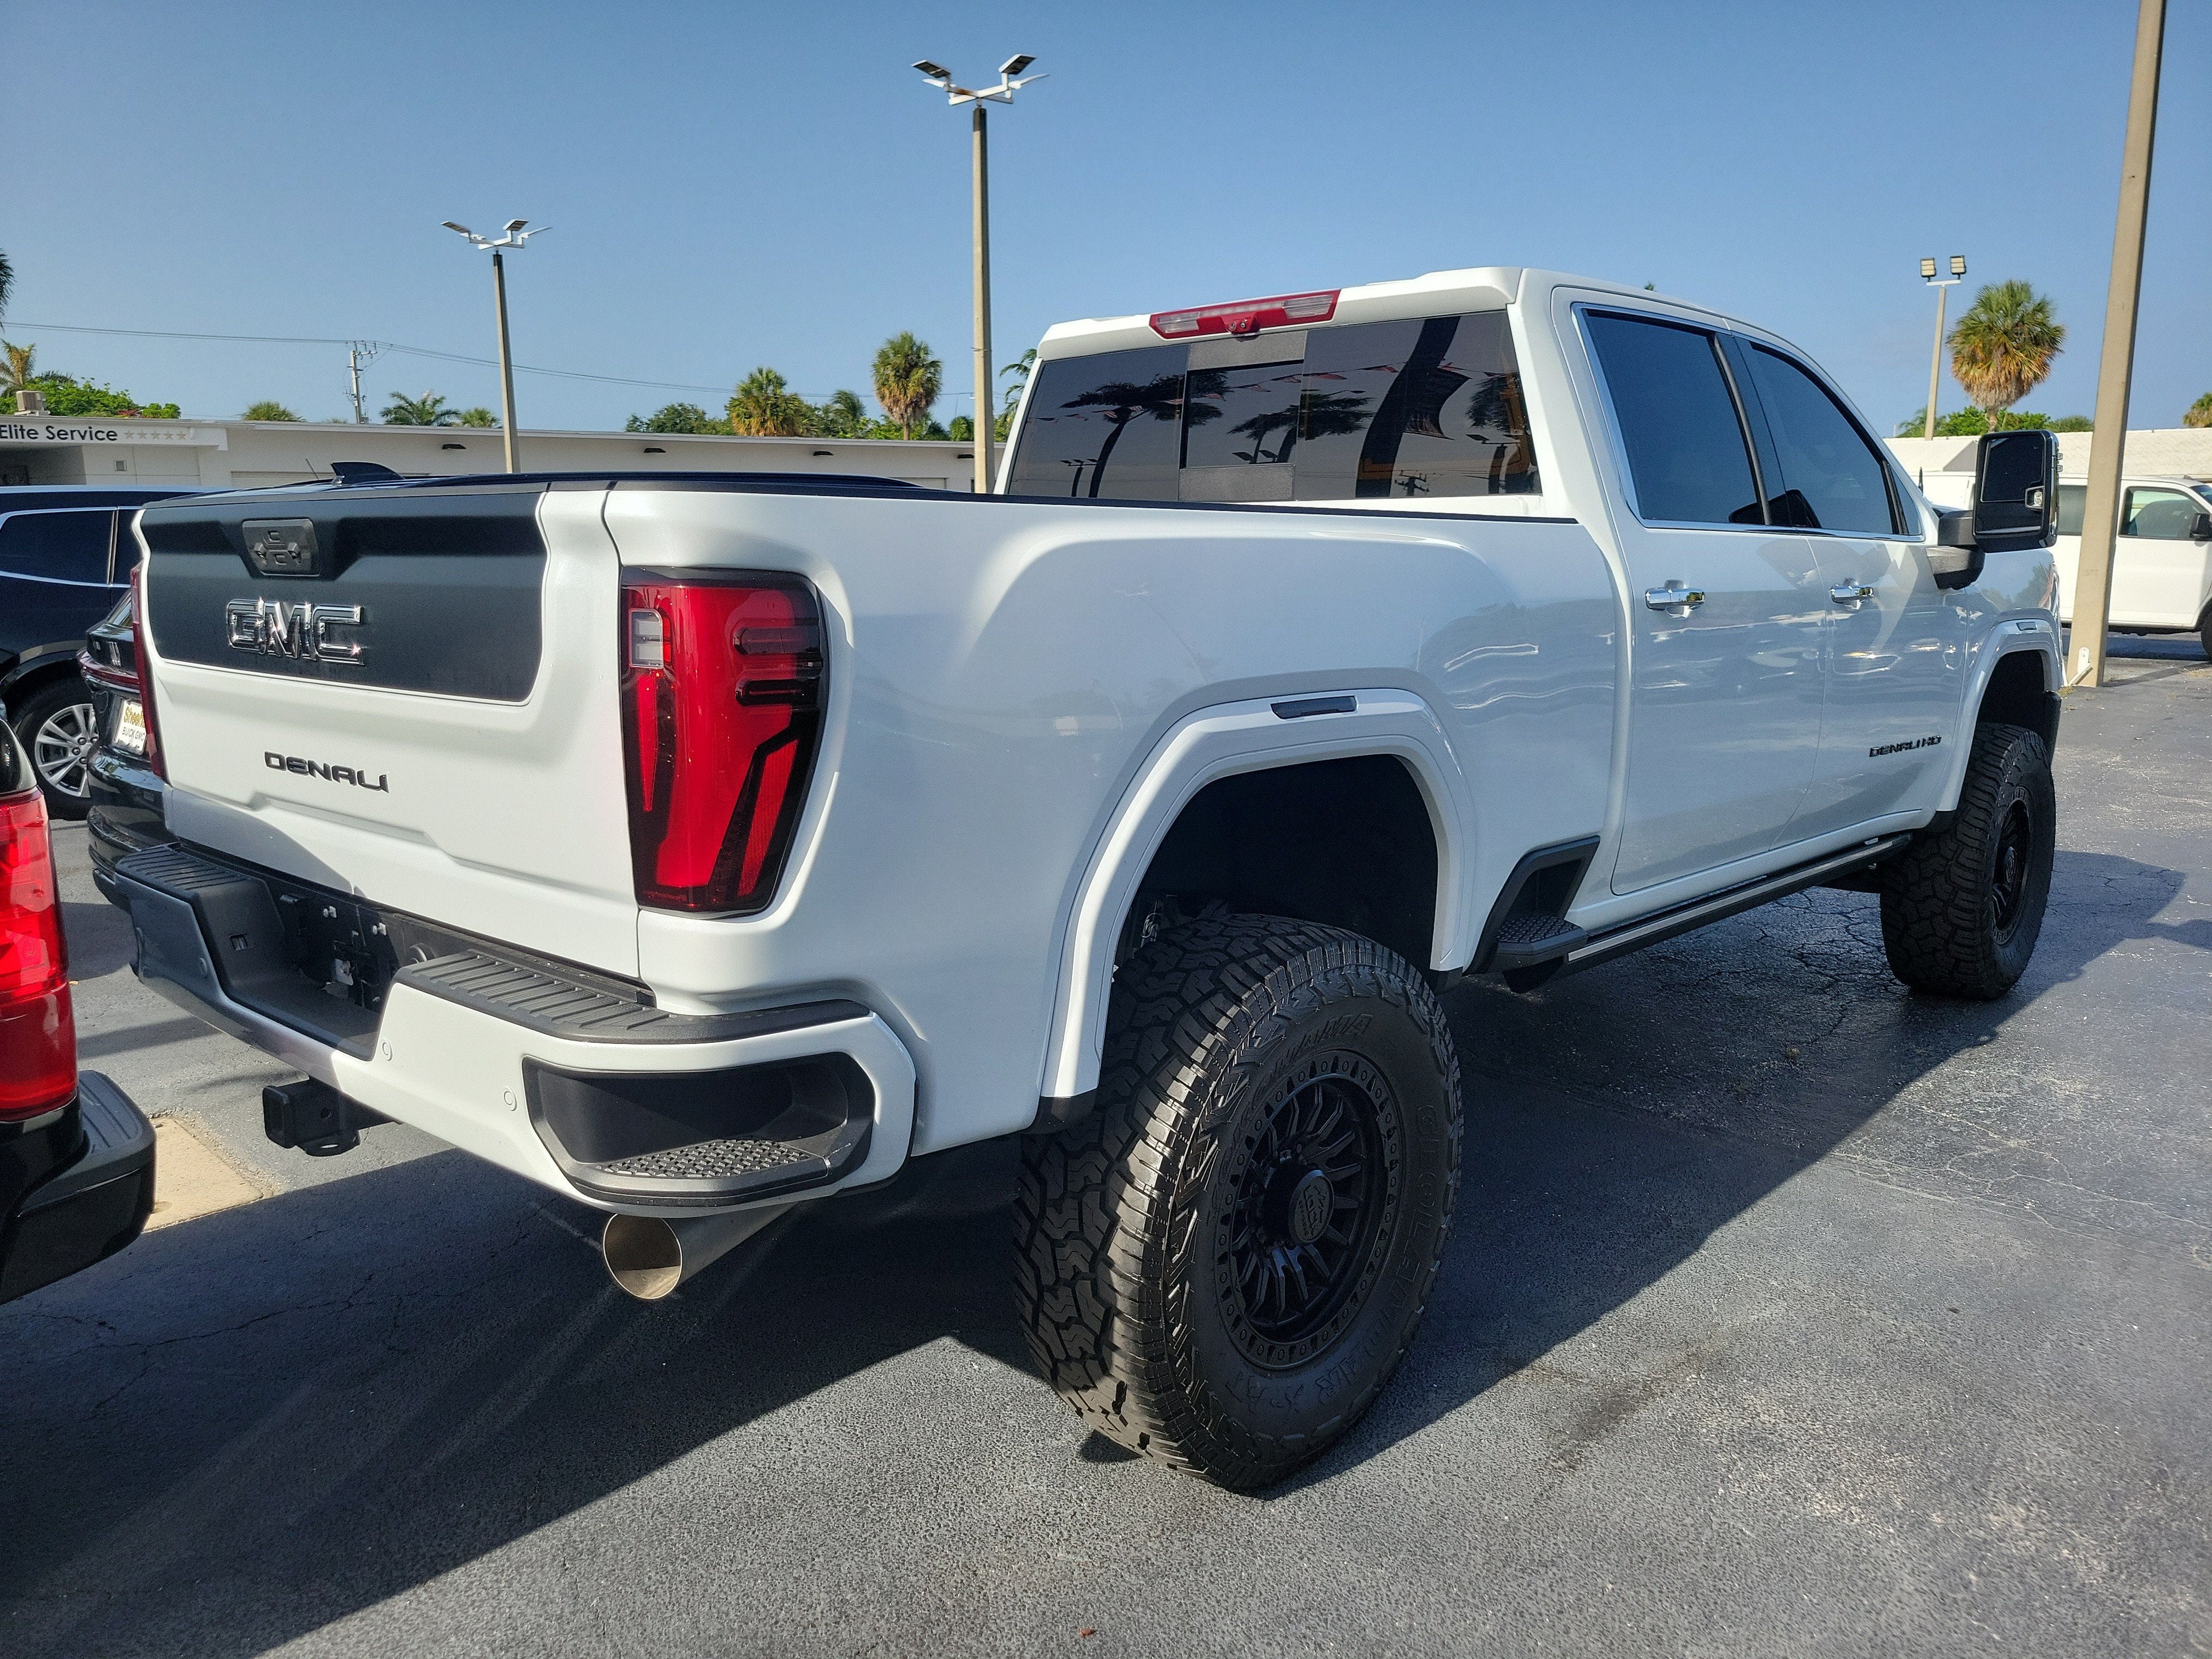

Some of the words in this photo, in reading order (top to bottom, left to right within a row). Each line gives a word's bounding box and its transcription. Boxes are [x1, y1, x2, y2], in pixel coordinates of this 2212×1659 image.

[0, 424, 39, 439] Elite
[46, 425, 118, 441] Service
[226, 598, 364, 665] GMC
[122, 727, 136, 738] BUICK
[135, 731, 145, 741] GMC
[1869, 739, 1920, 758] DENALI
[1921, 735, 1942, 747] HD
[264, 751, 389, 793] DENALI
